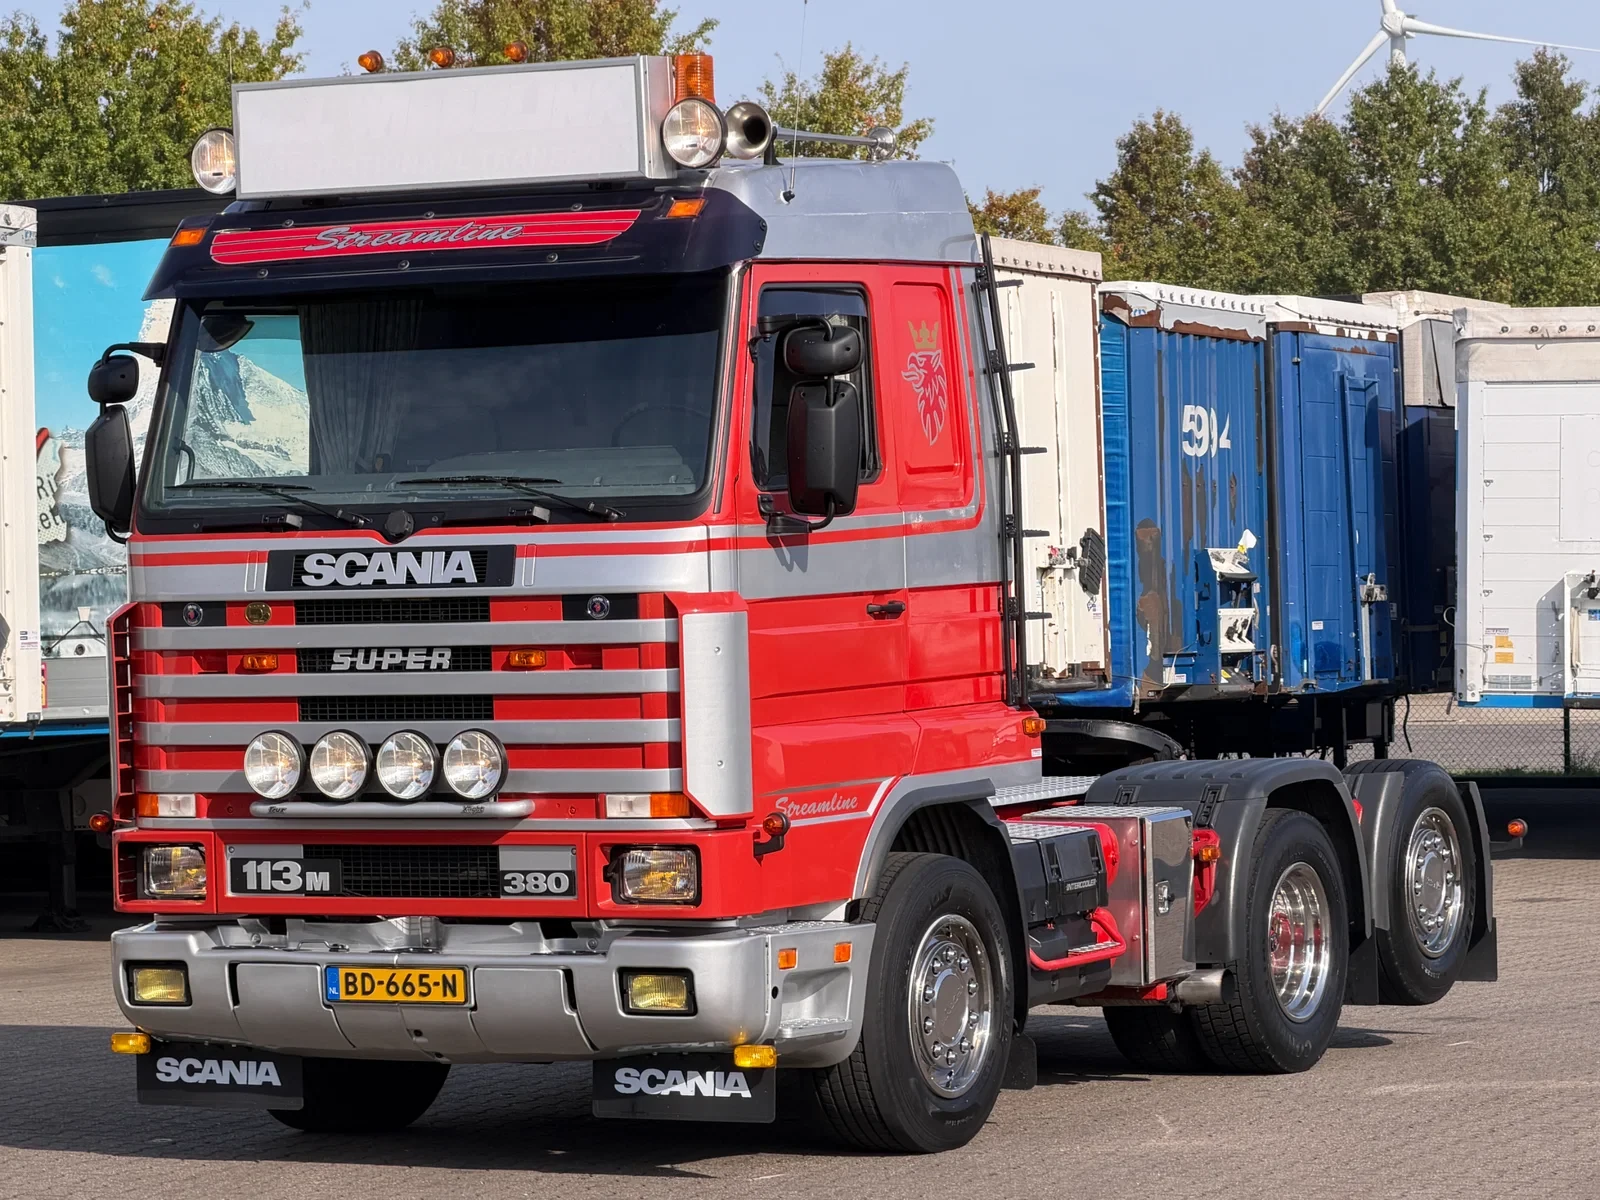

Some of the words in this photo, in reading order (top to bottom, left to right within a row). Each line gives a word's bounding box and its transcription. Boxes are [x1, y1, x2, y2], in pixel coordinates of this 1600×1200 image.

[304, 221, 523, 251] Streamline
[301, 551, 478, 587] SCANIA
[331, 648, 452, 671] SUPER
[775, 792, 858, 817] Streamline
[503, 872, 570, 894] 380
[328, 987, 339, 995] NL
[344, 972, 458, 998] BD-665-N
[156, 1057, 282, 1086] SCANIA
[614, 1067, 752, 1098] SCANIA
